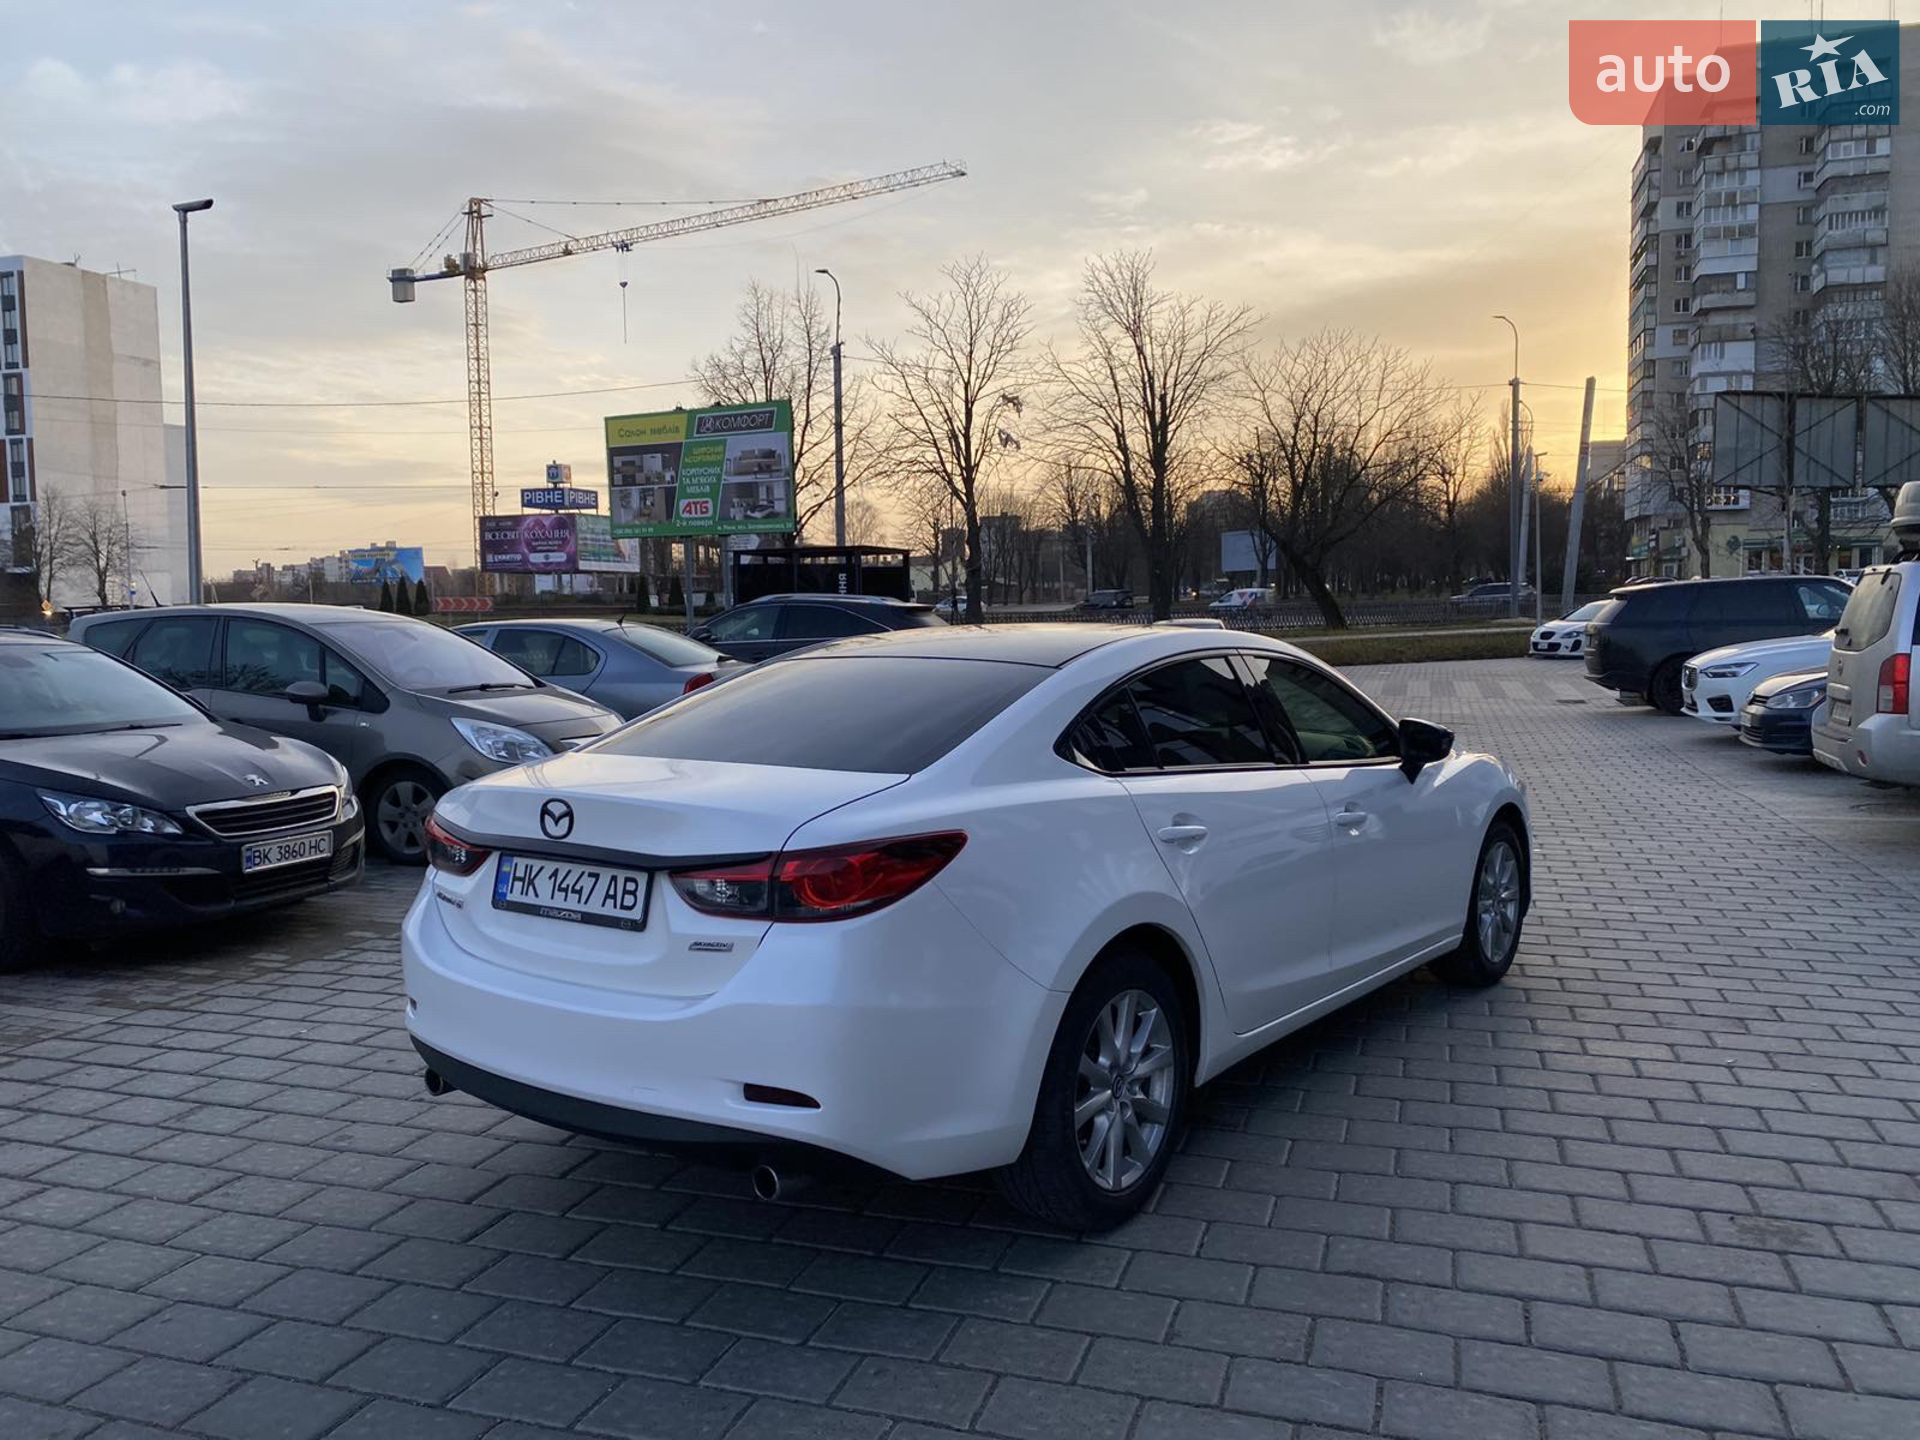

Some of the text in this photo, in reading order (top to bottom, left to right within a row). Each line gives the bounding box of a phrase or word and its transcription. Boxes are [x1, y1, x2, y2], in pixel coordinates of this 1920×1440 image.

[715, 413, 770, 430] КОМФОРТ
[618, 425, 680, 438] Салон меблів
[523, 490, 563, 504] РІВНЕ
[569, 490, 596, 505] РІВНЕ
[681, 500, 710, 516] АТБ
[276, 842, 306, 862] 3860
[509, 862, 639, 911] HK 1447 AB
